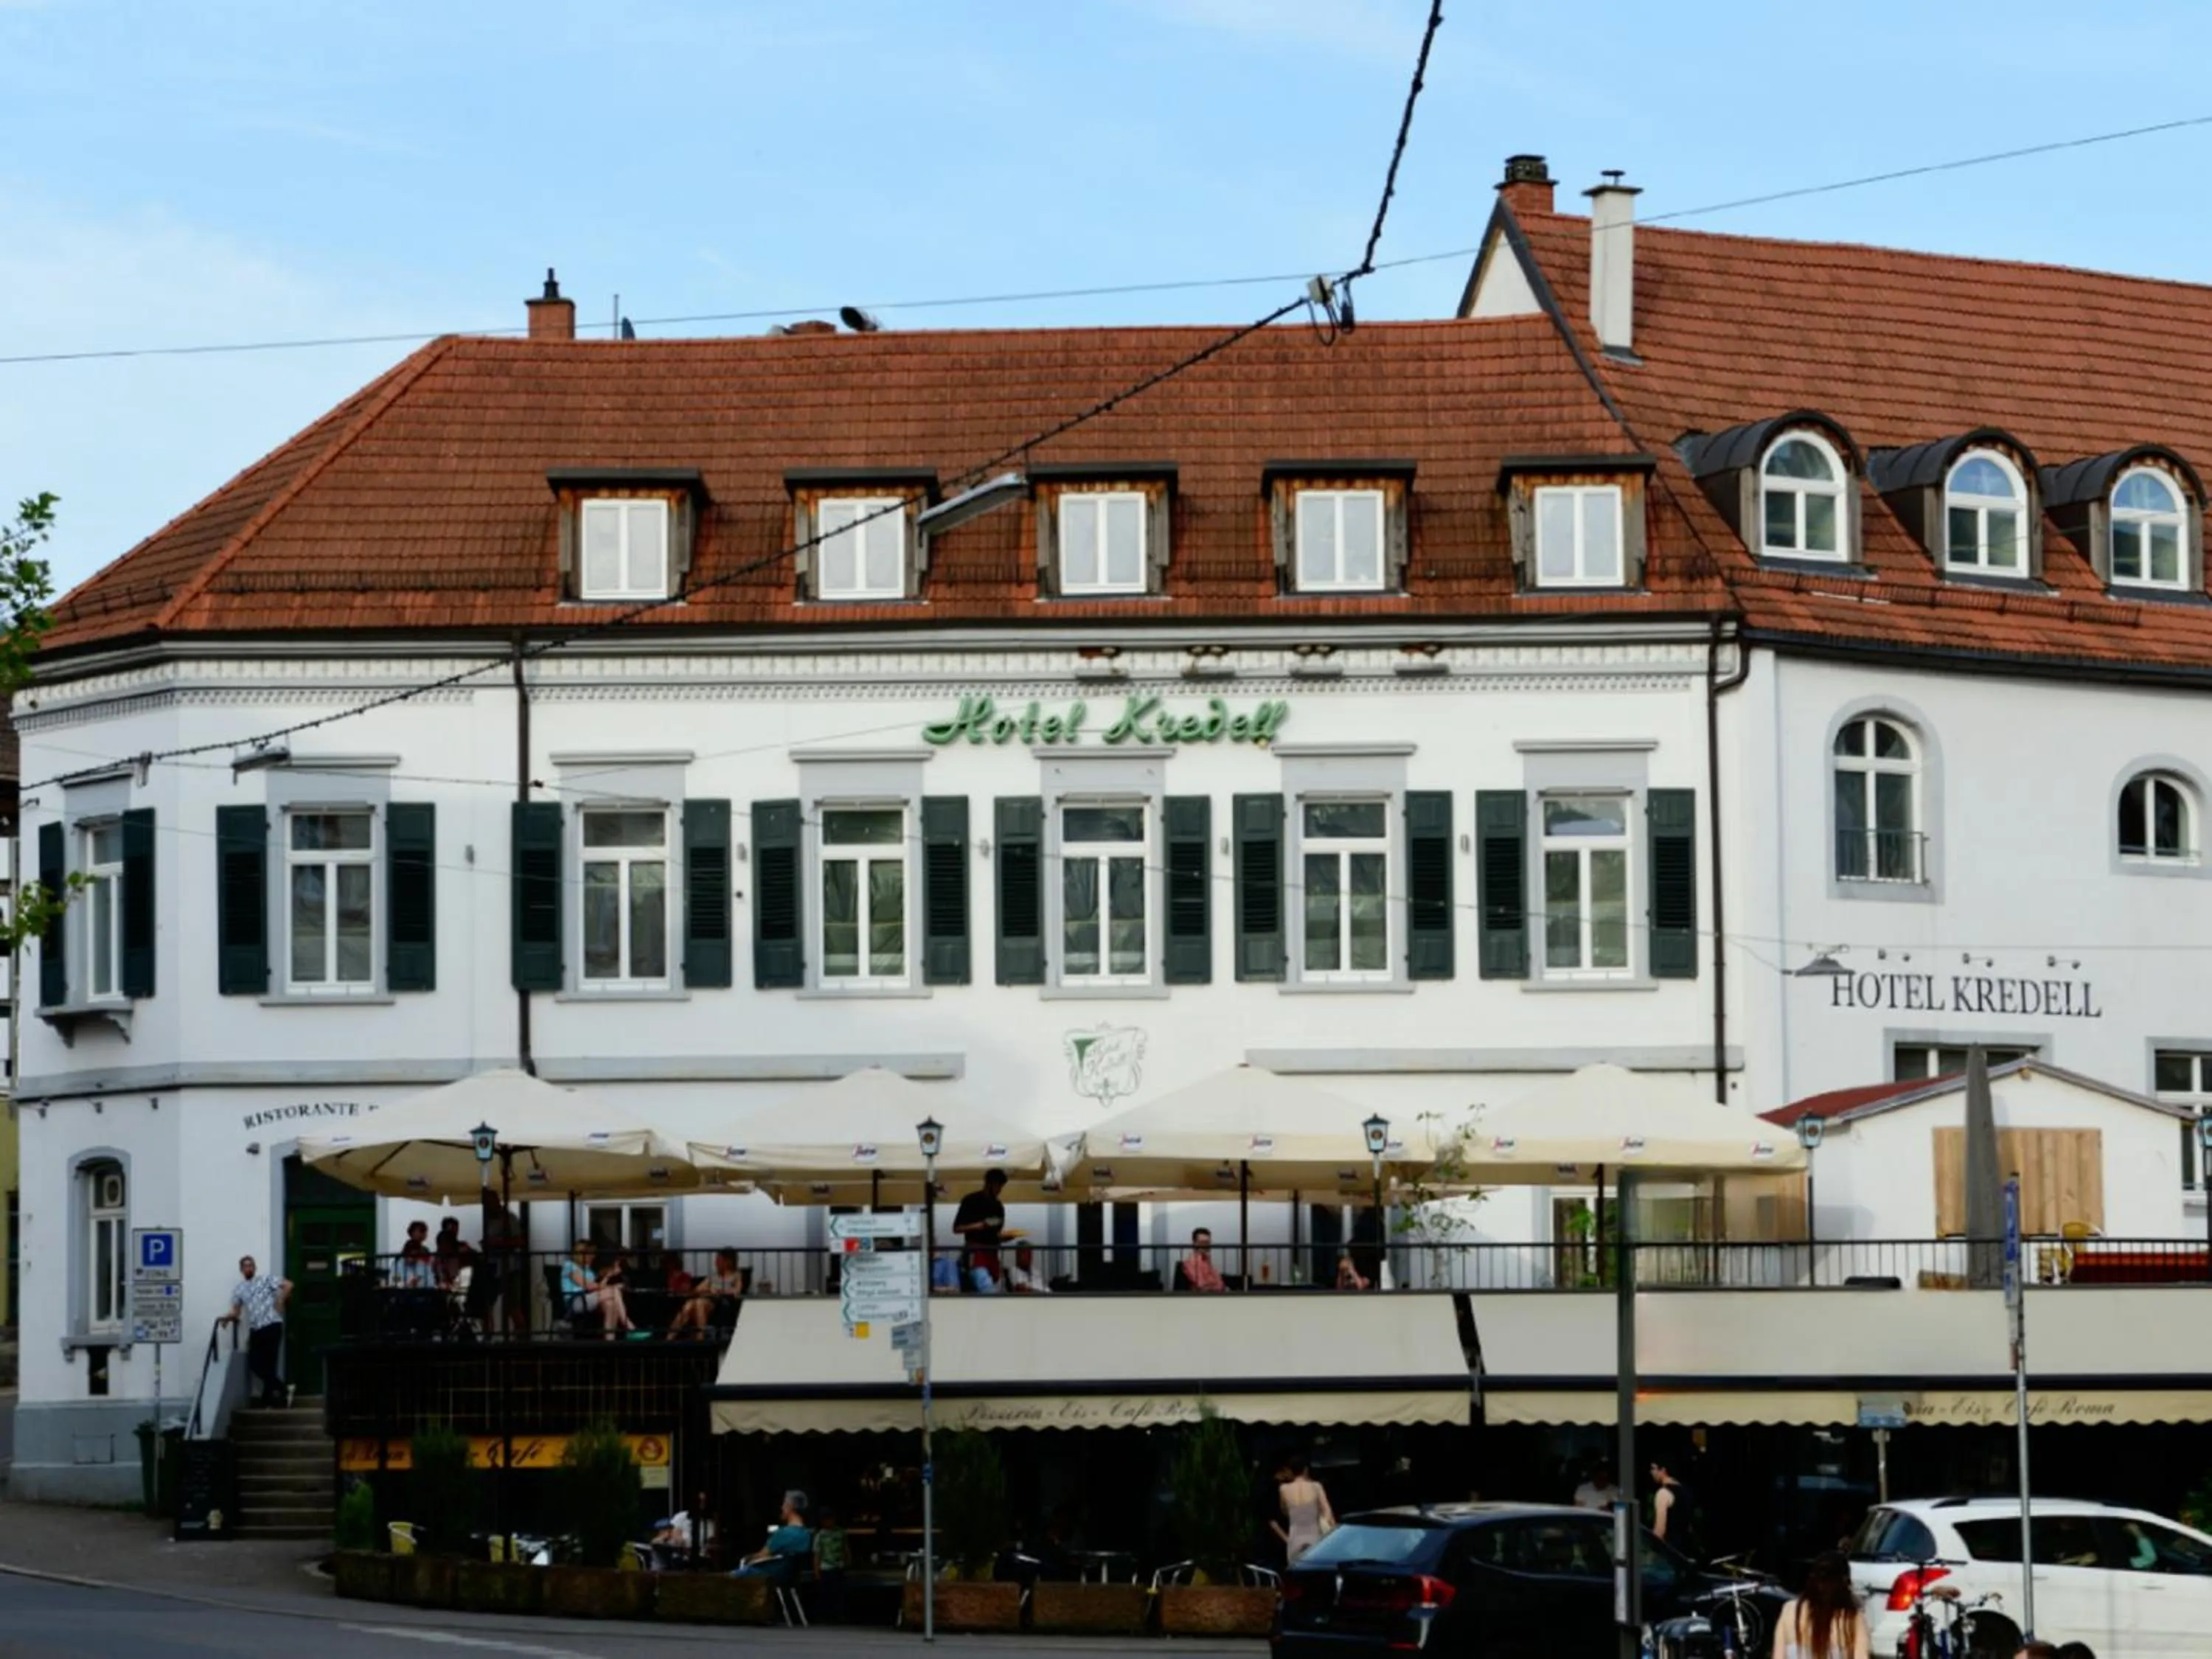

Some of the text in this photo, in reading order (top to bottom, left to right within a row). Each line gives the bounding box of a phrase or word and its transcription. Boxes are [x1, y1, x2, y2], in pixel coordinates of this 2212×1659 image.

[922, 695, 1289, 746] Hotel Kredell
[1831, 971, 2102, 1018] HOTEL KREDELL
[242, 1102, 360, 1130] RISTORANTE
[149, 1238, 165, 1262] P
